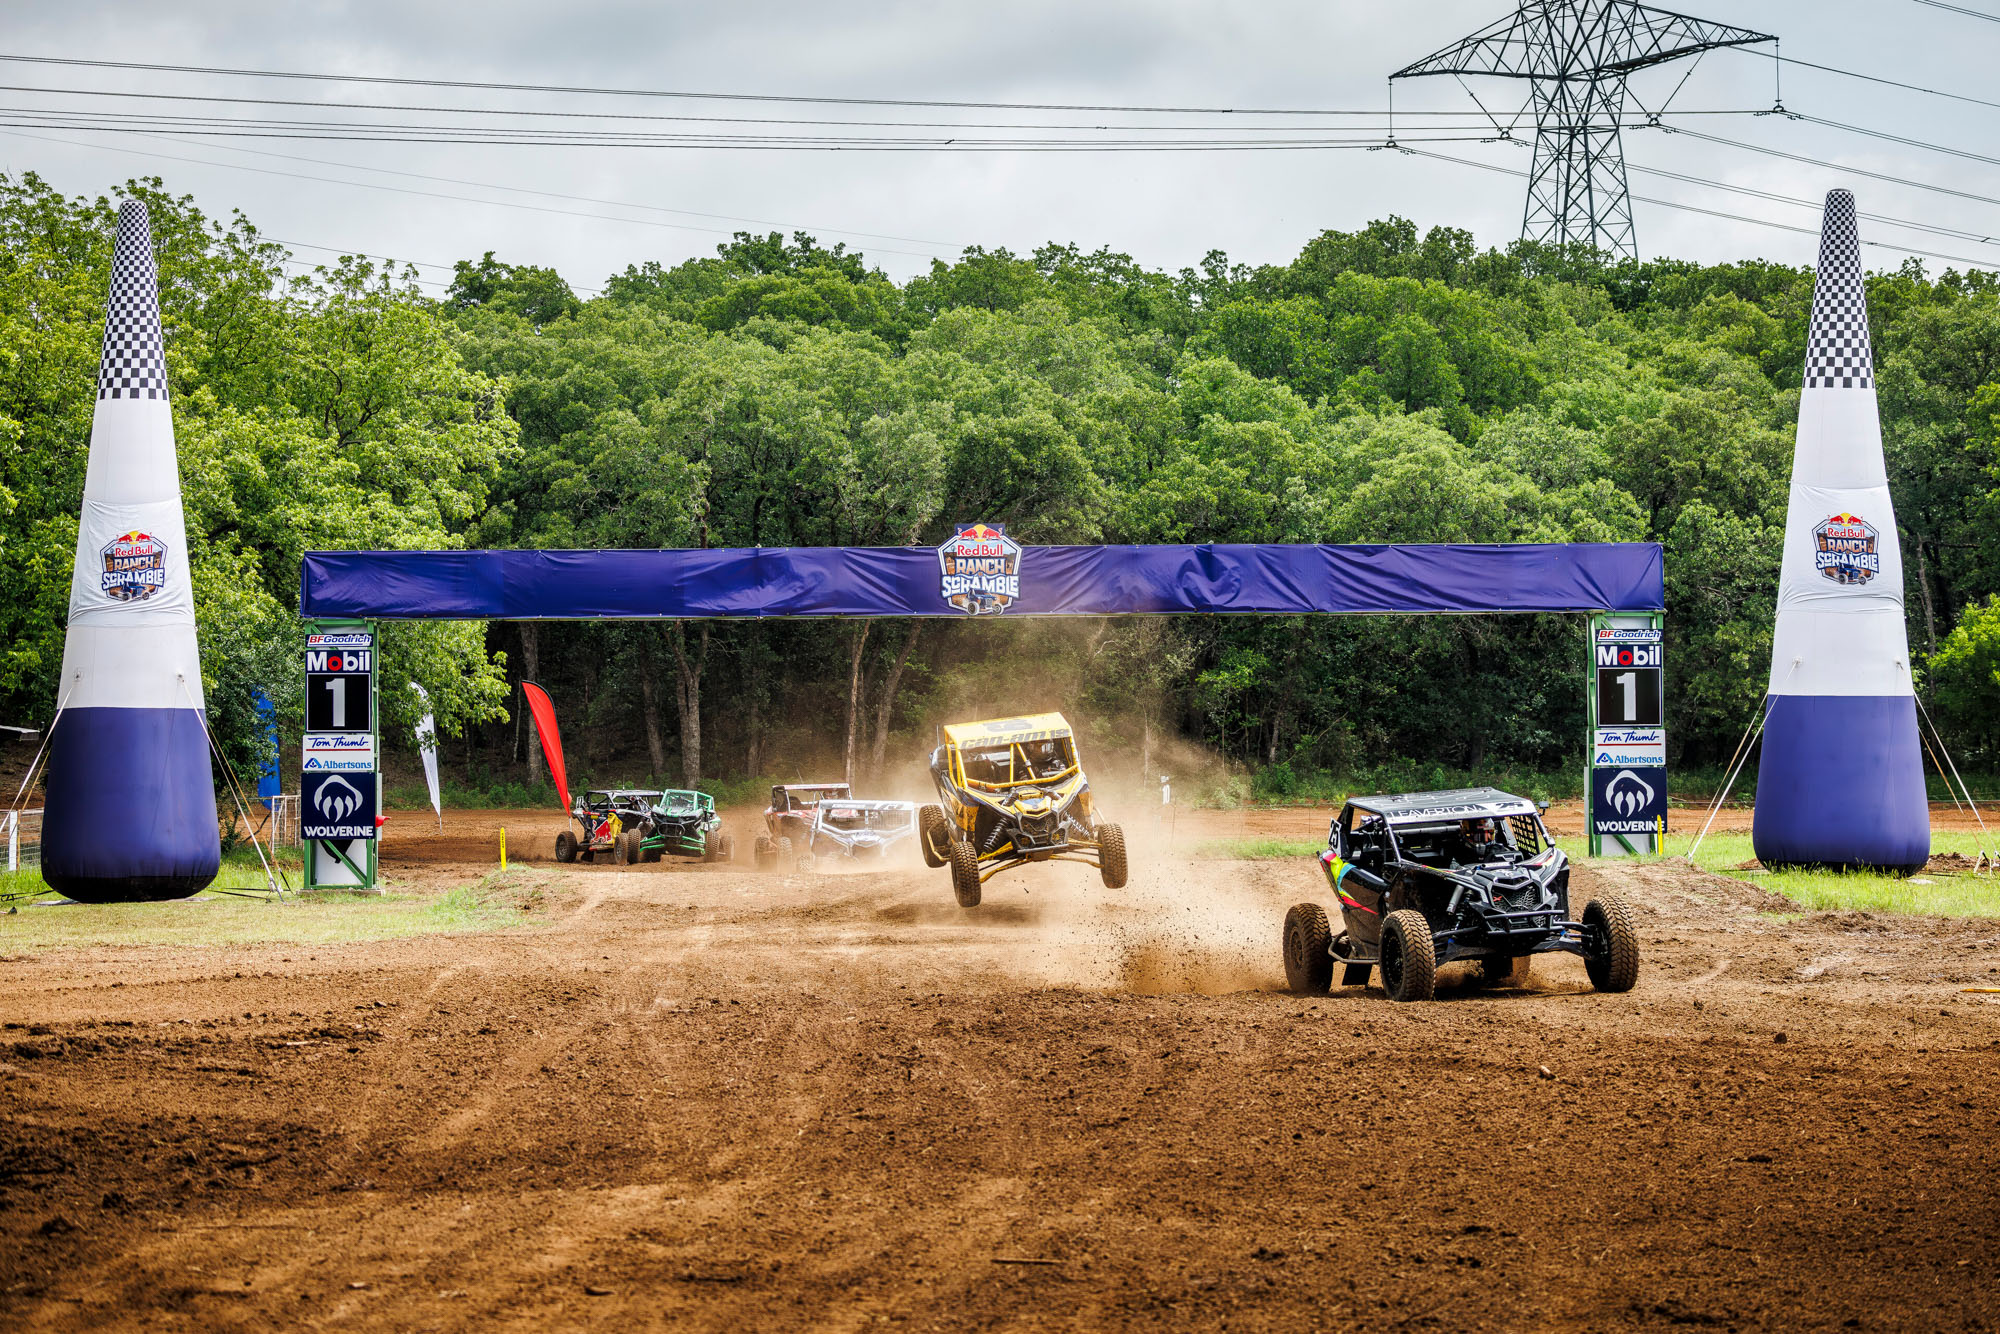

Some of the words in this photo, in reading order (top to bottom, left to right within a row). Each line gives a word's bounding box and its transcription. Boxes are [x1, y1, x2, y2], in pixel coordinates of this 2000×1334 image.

[1827, 527, 1846, 537] Red
[1847, 529, 1865, 538] Bull
[115, 547, 134, 557] Red
[135, 545, 153, 555] Bull
[957, 544, 980, 556] Red
[981, 544, 1003, 556] Bull
[1826, 539, 1867, 553] RANCH
[114, 557, 153, 571] RANCH
[955, 558, 1006, 575] RANCH
[1817, 552, 1878, 573] SCRAMBLE
[102, 568, 164, 590] SCRAMBLE
[941, 575, 1019, 599] SCRAMBLE
[309, 635, 372, 644] BFGoodrich
[1599, 629, 1661, 640] BFGoodrich
[307, 651, 370, 672] Mobil
[1598, 645, 1660, 666] Mobil
[325, 677, 346, 727] 1
[1616, 672, 1637, 721] 1
[308, 737, 331, 748] Tom
[331, 736, 368, 748] Thumb
[1599, 732, 1622, 743] Tom
[1622, 731, 1659, 743] Thumb
[323, 760, 372, 769] Albertsons
[1614, 754, 1663, 764] Albertsons
[304, 826, 373, 837] WOLVERINE
[1596, 821, 1665, 832] WOLVERINE
